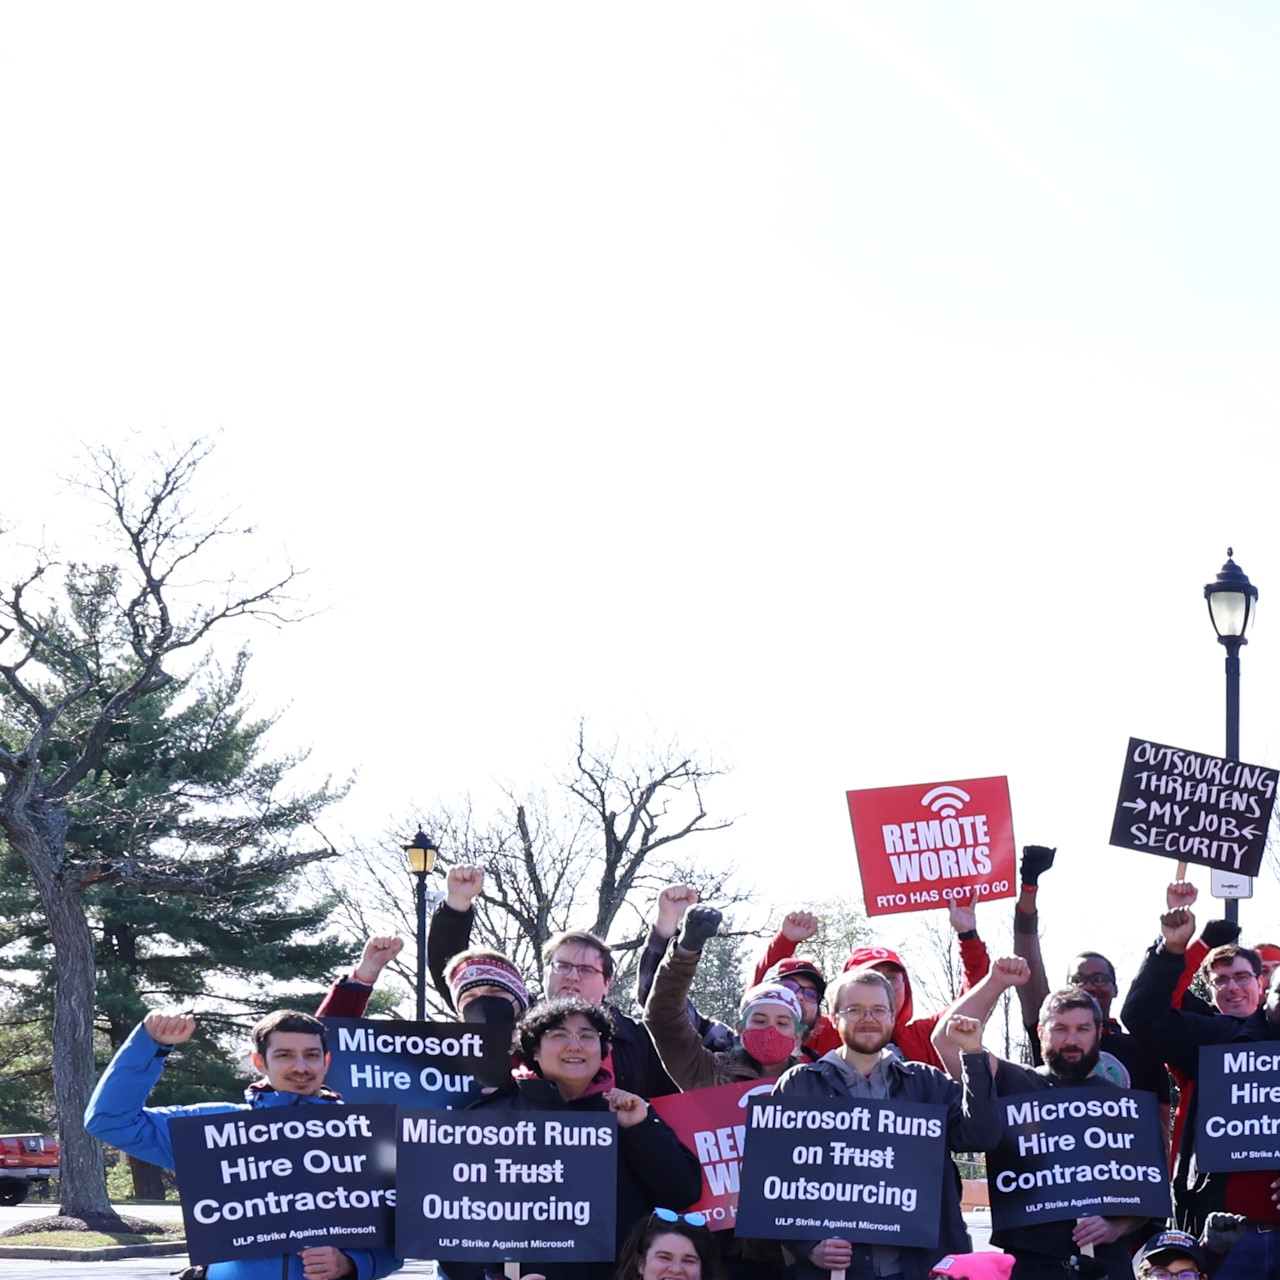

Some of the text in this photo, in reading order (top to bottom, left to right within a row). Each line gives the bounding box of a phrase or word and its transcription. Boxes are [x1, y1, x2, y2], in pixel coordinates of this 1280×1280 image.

[1134, 743, 1274, 801] OUTSOURCING
[1134, 770, 1262, 818] THREATENS
[882, 815, 990, 855] REMOTE
[1148, 801, 1240, 837] MY JOB
[1131, 822, 1249, 869] SECURITY
[889, 845, 992, 884] WORKS
[877, 880, 1008, 907] RTO HAS GOT TO GO
[752, 1105, 941, 1137] Microsoft Runs
[1007, 1097, 1139, 1126] Microsoft
[204, 1114, 372, 1149] Microsoft
[403, 1118, 612, 1146] Microsoft Runs
[1018, 1127, 1134, 1156] Hire Our
[221, 1150, 366, 1184] Hire Our
[453, 1159, 564, 1183] on Trust
[793, 1142, 895, 1169] on Trust
[1231, 1151, 1248, 1159] ULP
[996, 1160, 1161, 1192] Contractors
[193, 1187, 396, 1224] Contractors
[423, 1194, 590, 1225] Outsourcing
[764, 1176, 917, 1212] Outsourcing
[439, 1238, 574, 1249] ULP Strike Against Microsoft
